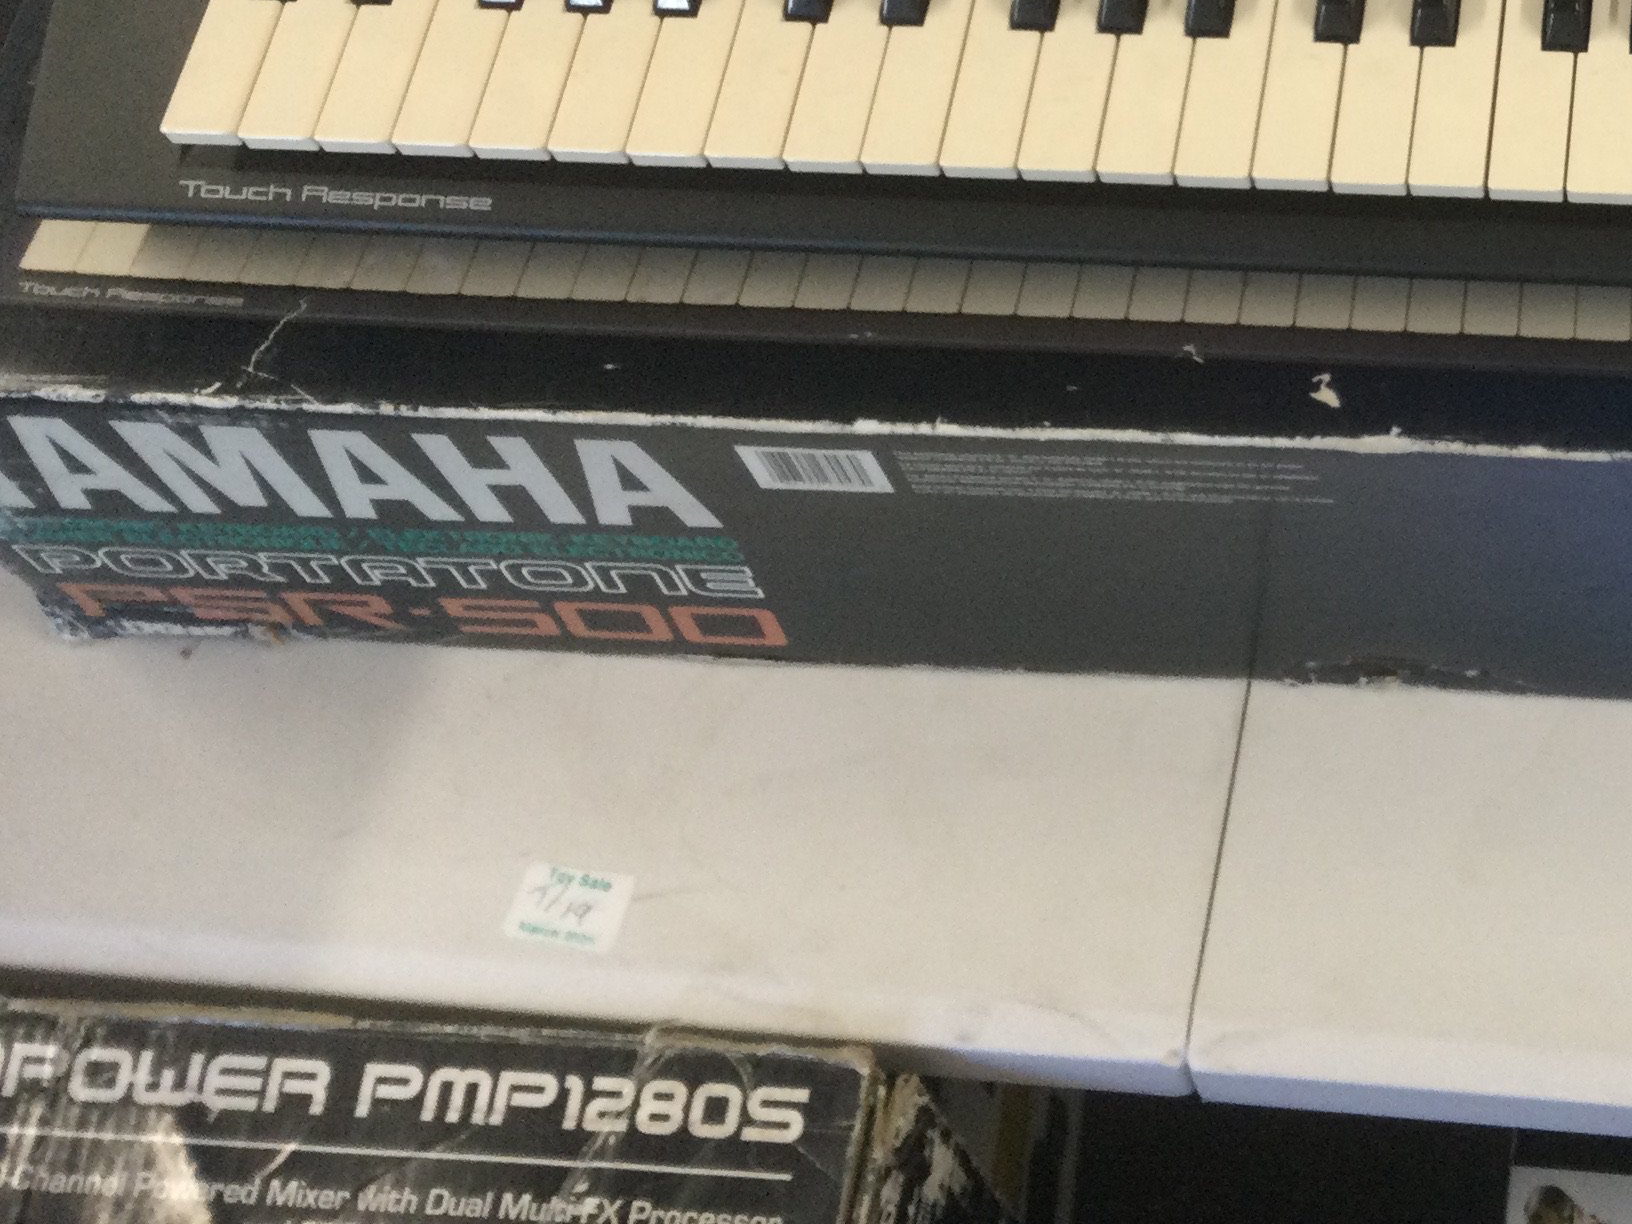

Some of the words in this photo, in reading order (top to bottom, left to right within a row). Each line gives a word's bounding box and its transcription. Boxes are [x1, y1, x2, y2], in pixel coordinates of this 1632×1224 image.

[179, 179, 293, 202] Touch
[301, 184, 493, 212] Response
[17, 280, 101, 298] Touch
[106, 287, 244, 307] Response
[0, 415, 723, 528] AMAHA
[11, 544, 765, 599] PORTATONE
[56, 582, 789, 647] PSR-500
[579, 874, 612, 892] Sale
[0, 1042, 331, 1116] POWER
[354, 1061, 811, 1144] PMP1280S
[265, 1179, 350, 1211] Mixer
[425, 1187, 491, 1220] Dual
